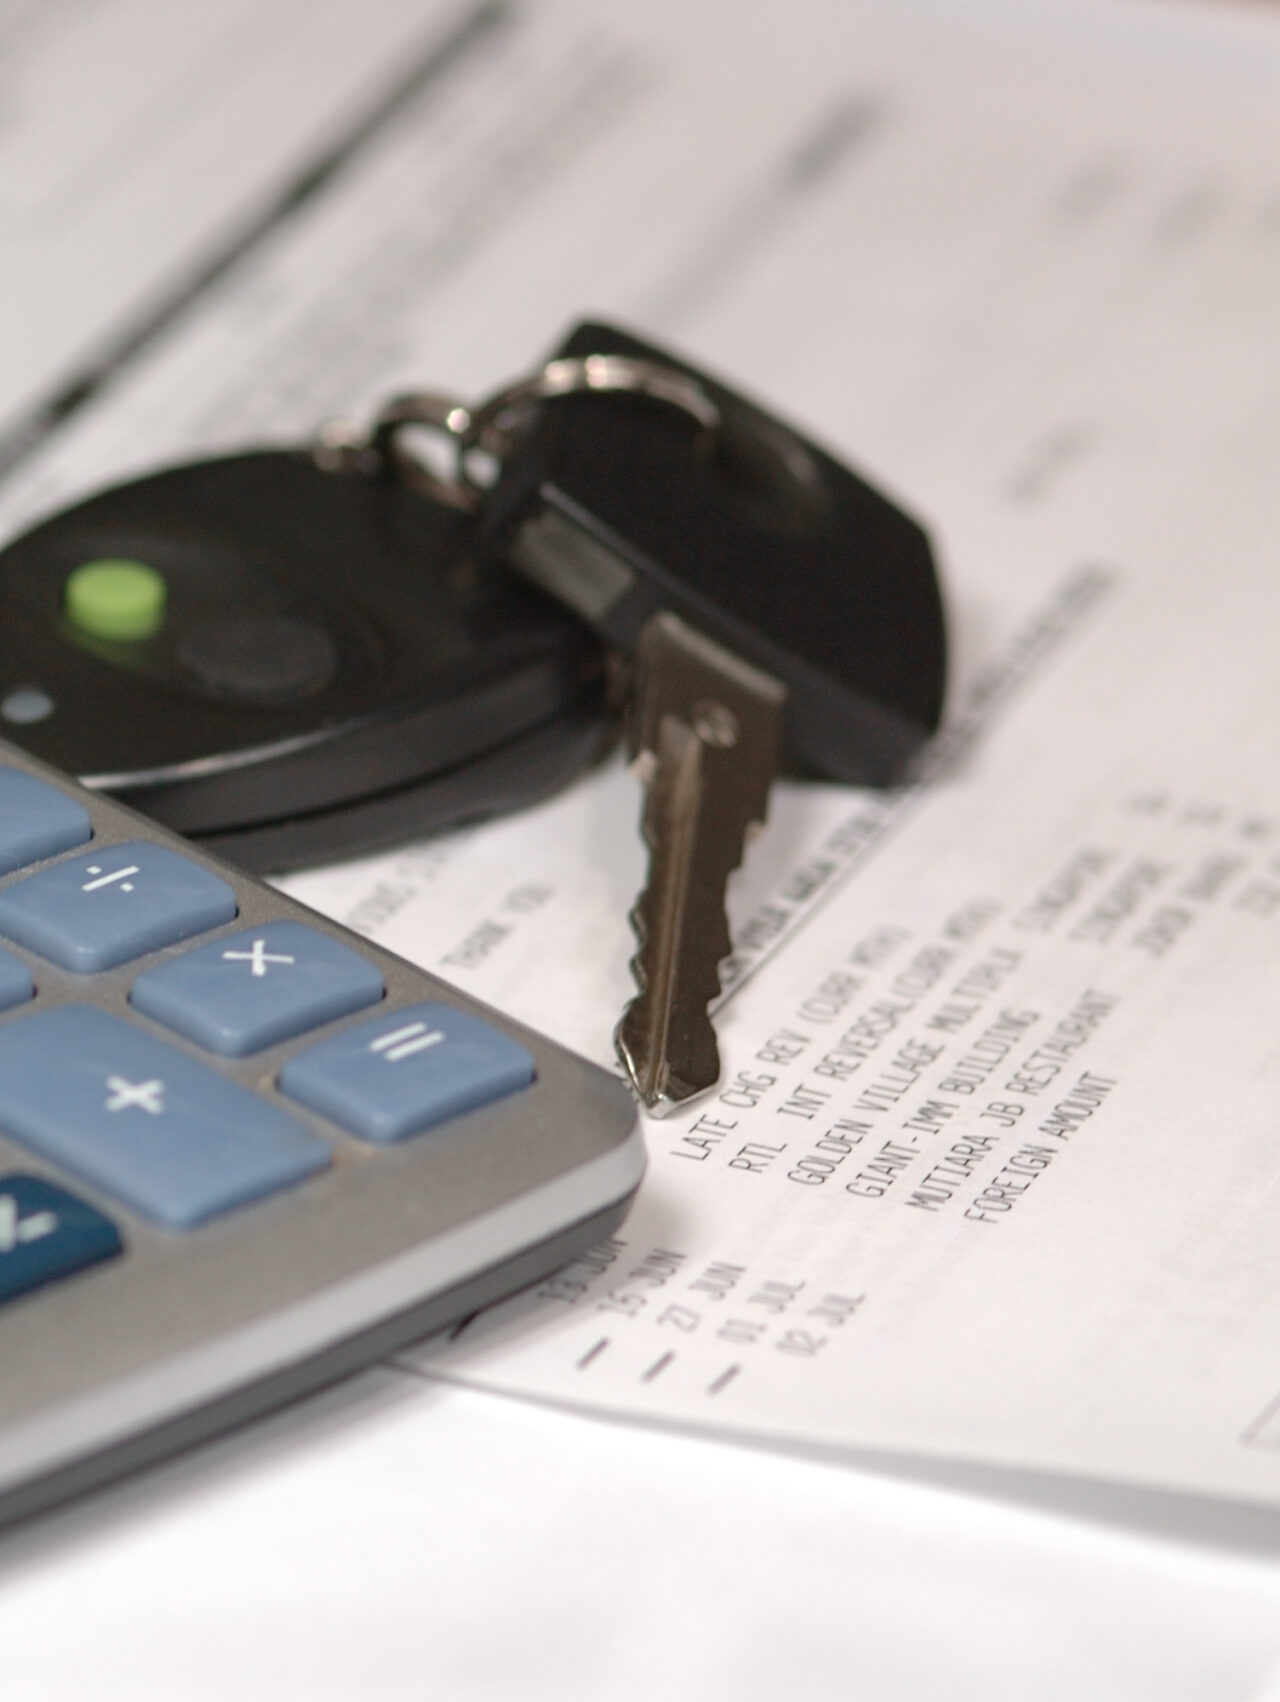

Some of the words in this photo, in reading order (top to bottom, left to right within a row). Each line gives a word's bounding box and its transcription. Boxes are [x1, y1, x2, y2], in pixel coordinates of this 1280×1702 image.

[670, 1112, 737, 1162] LATE
[719, 1070, 777, 1110] CHG
[756, 1028, 812, 1068] REV
[728, 1140, 788, 1175] RTL
[777, 1081, 832, 1121] INT
[786, 1116, 874, 1187] GOLDEN
[862, 1036, 945, 1113] VILLAGE
[845, 1099, 960, 1199] GIANT-IMM
[937, 1008, 1042, 1096] BUILDING
[904, 1132, 1001, 1212] MUTIARA
[978, 1101, 1026, 1129] JB
[1005, 988, 1121, 1096] RESTAURANT
[963, 1142, 1059, 1224] FOREIGN
[1038, 1070, 1119, 1141] AMOUNT
[627, 1247, 687, 1288] JUN
[686, 1260, 748, 1301] JUN
[746, 1279, 807, 1314] JUL
[806, 1292, 867, 1328] JUL
